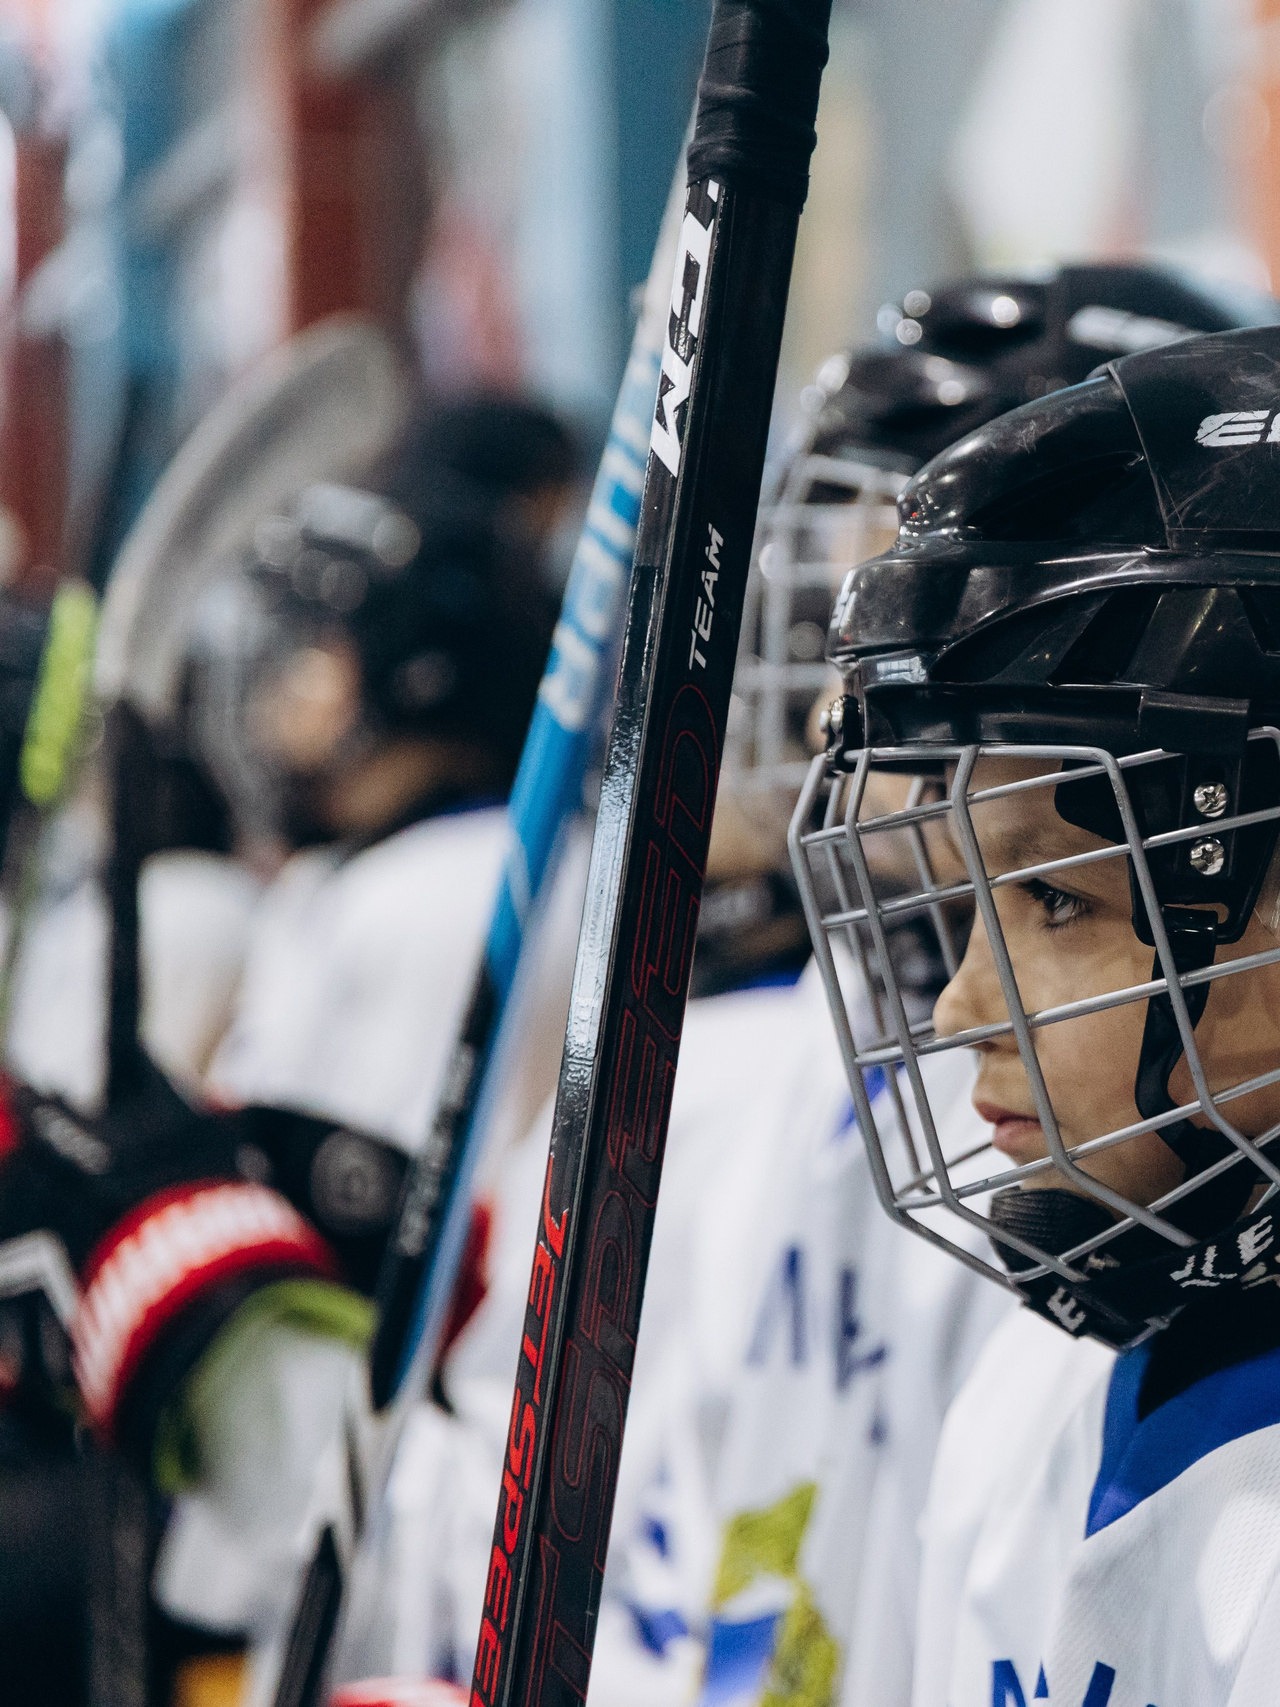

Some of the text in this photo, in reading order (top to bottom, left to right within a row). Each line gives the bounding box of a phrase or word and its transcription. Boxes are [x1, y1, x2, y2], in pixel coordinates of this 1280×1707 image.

[650, 179, 720, 478] CM
[688, 523, 725, 671] TEAM
[468, 1151, 569, 1707] JETSPEE
